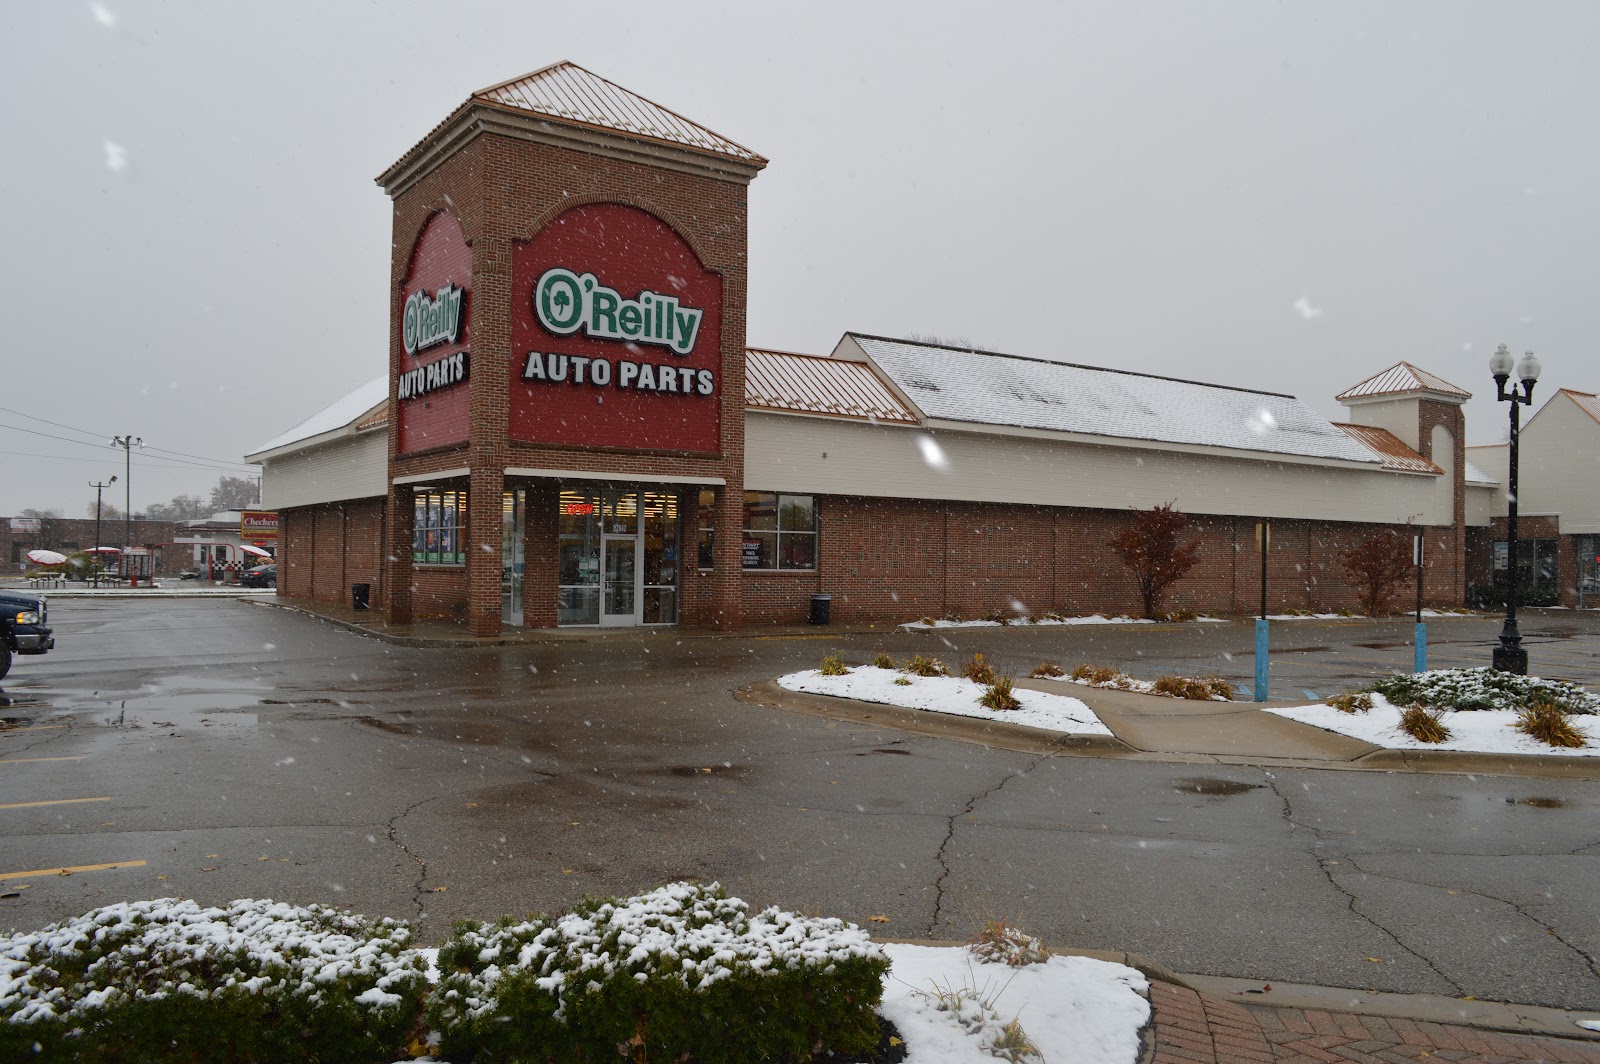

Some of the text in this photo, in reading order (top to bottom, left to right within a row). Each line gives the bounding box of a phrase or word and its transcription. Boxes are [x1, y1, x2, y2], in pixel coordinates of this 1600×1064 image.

[403, 290, 460, 351] O'Reilly
[540, 272, 700, 350] O'Reilly
[398, 352, 464, 400] AUTO PARTS
[524, 351, 714, 395] AUTO PARTS
[244, 517, 279, 526] Checkers
[566, 503, 594, 515] OPEN
